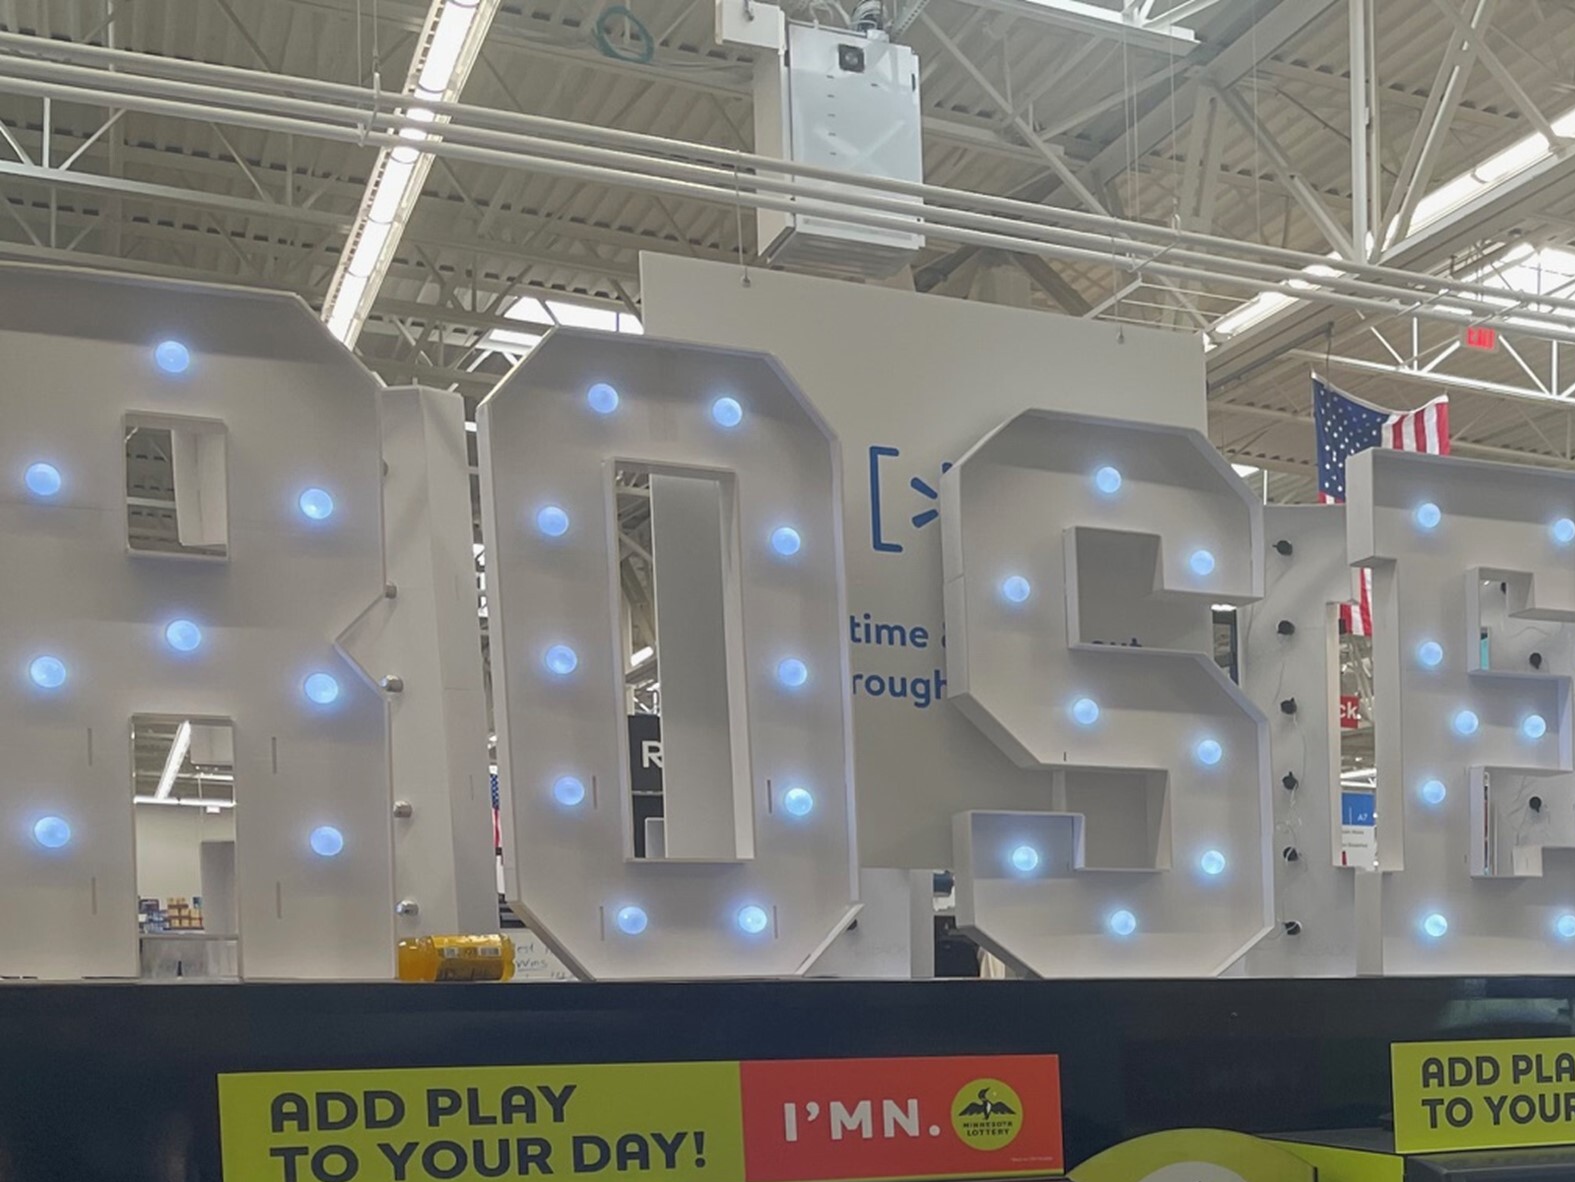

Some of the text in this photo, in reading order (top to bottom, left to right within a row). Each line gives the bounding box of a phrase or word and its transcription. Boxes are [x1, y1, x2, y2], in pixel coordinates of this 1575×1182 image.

[850, 613, 929, 649] time
[1422, 1056, 1500, 1088] ADD
[271, 1085, 578, 1133] ADD PLAY
[962, 1121, 1013, 1129] MINNESOTA
[1421, 1097, 1473, 1129] TO
[966, 1128, 1010, 1137] LOTTERY
[377, 1138, 554, 1182] YOUR
[572, 1131, 706, 1174] DAY!
